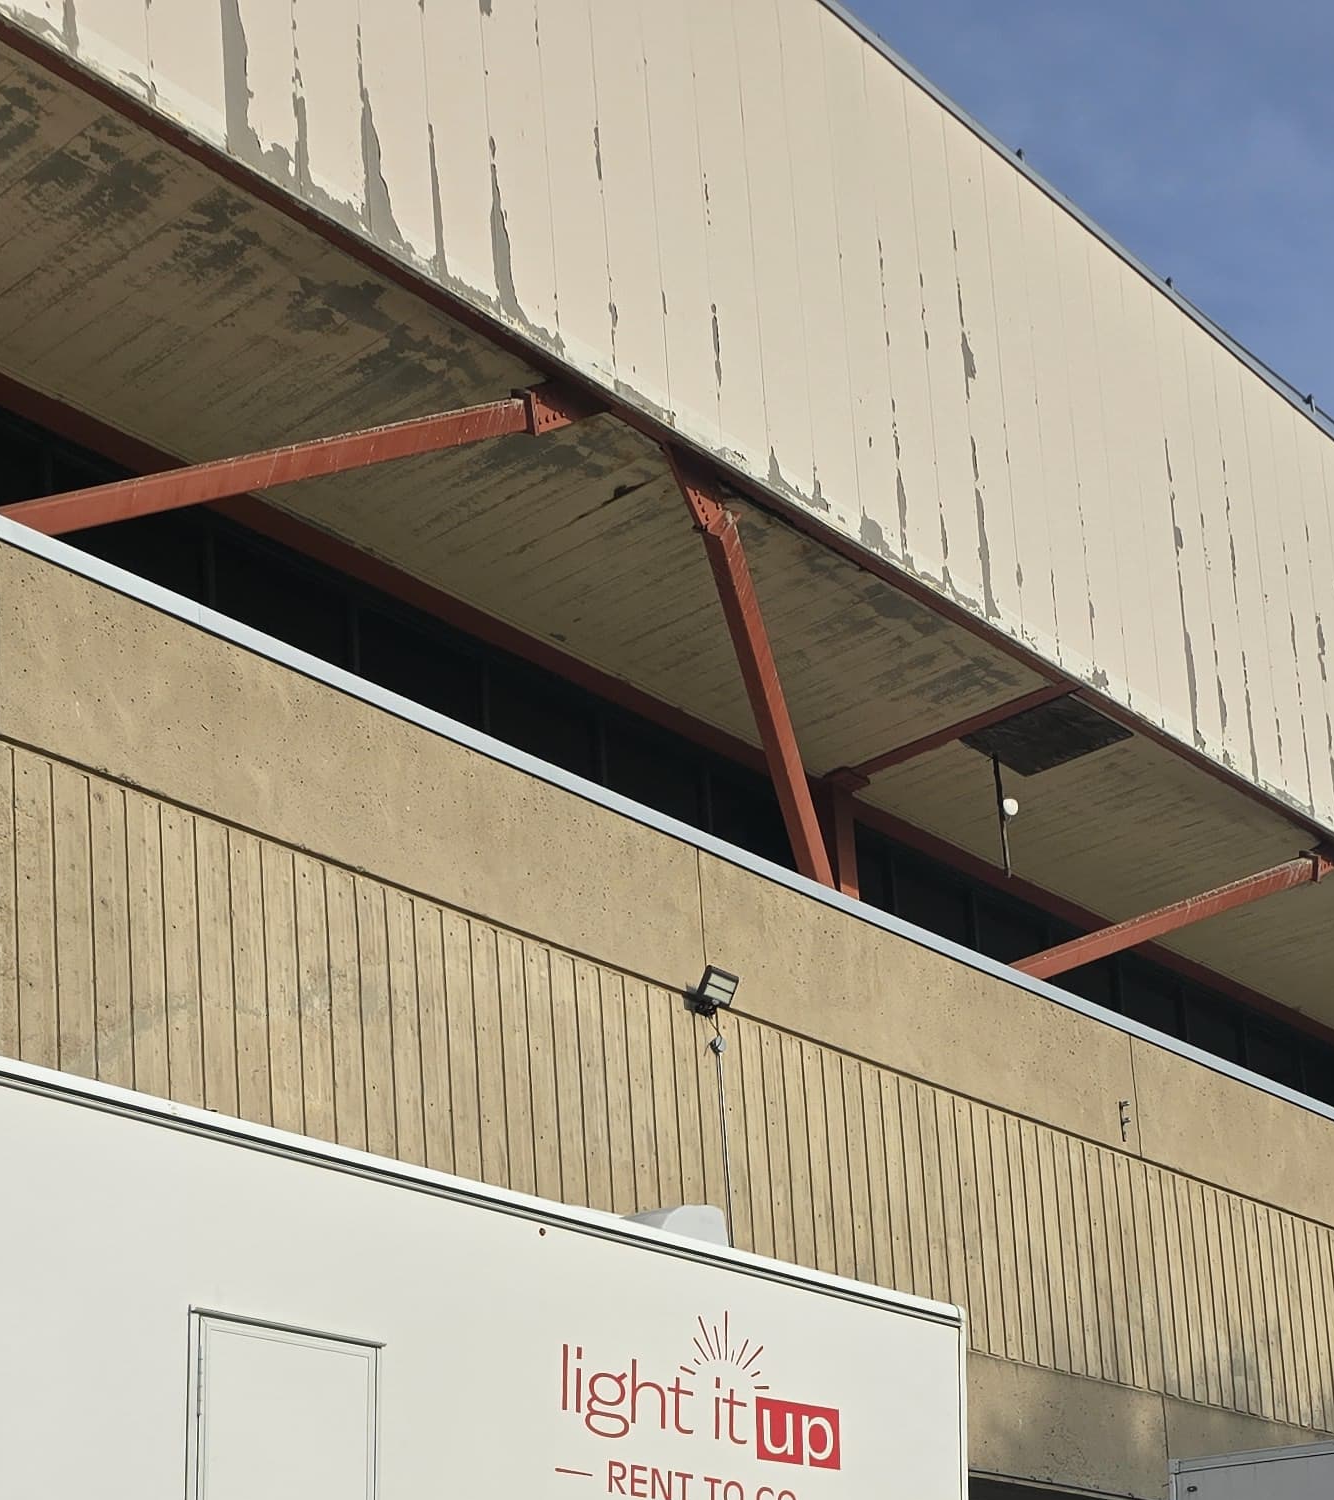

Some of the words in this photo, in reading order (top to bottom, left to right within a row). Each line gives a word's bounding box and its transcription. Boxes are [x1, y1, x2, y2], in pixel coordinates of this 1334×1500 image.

[561, 1343, 695, 1439] light
[714, 1376, 748, 1445] it
[761, 1408, 835, 1468] up
